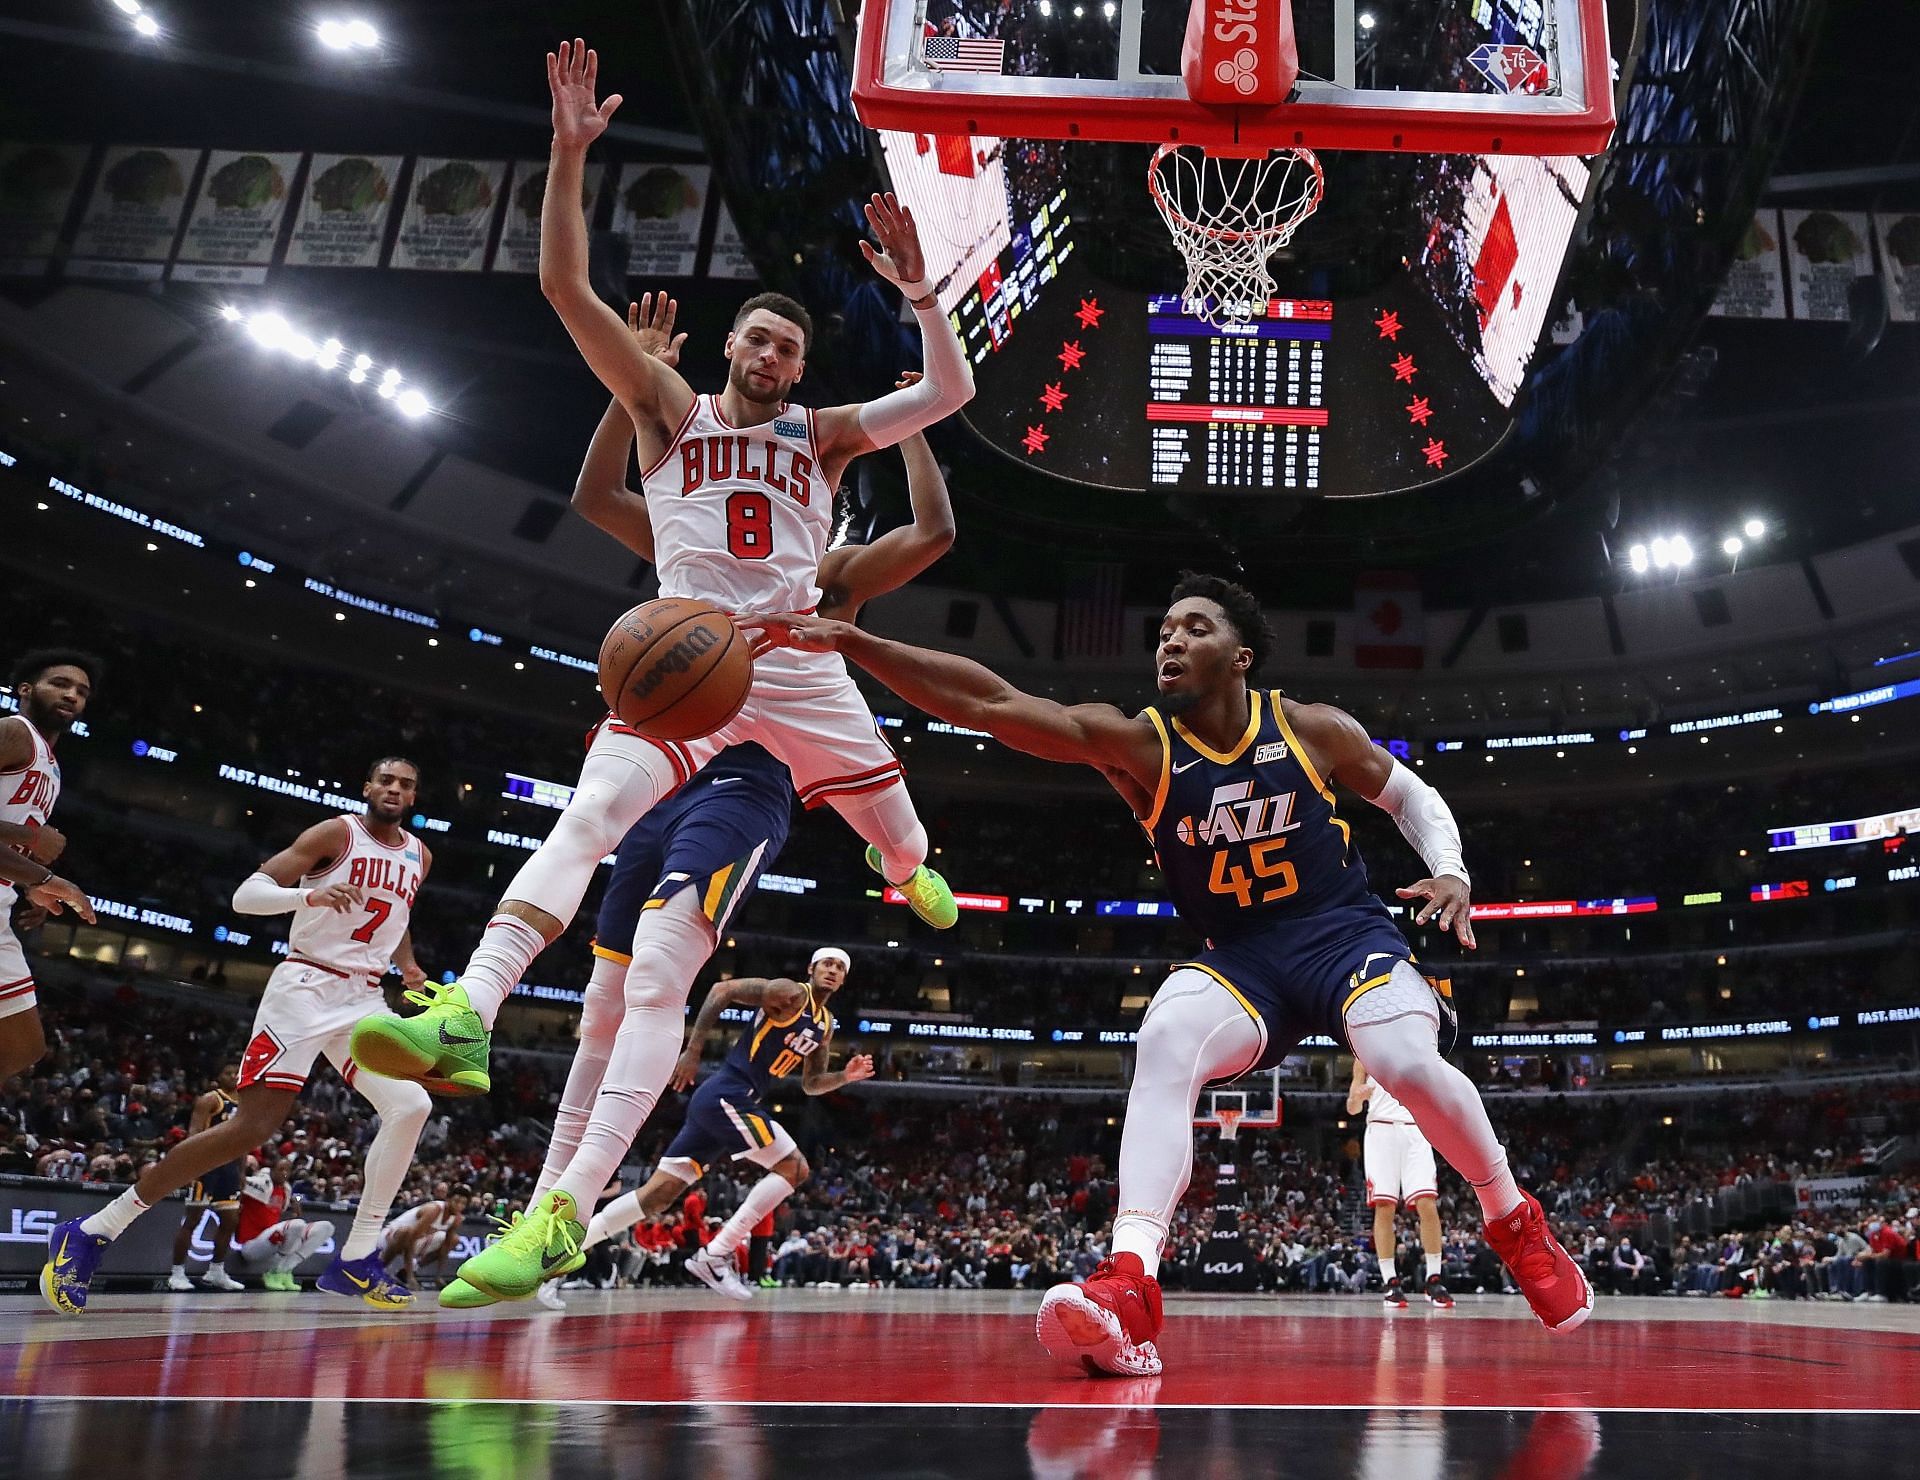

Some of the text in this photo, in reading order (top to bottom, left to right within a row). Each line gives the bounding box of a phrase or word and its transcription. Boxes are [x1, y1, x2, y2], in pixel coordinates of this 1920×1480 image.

[1512, 53, 1527, 68] 75
[680, 436, 813, 508] BULLS
[49, 476, 205, 548] FAST. RELIABLE. SECURE.
[726, 491, 773, 560] 8
[305, 577, 439, 629] FAST. RELIABLE. SECURE.
[529, 645, 558, 662] FAST.
[1670, 708, 1782, 734] FAST. RELIABLE. SECURE.
[1487, 733, 1594, 749] FAST. RELIABLE. SECURE.
[147, 746, 178, 762] AT&T
[1266, 750, 1285, 760] FIGHT
[219, 764, 368, 816] FAST. RELIABLE. SECUR
[1199, 780, 1301, 846] JAZZ
[488, 829, 520, 848] FAST.
[1208, 837, 1299, 907] 45
[1888, 866, 1919, 881] FAST.
[349, 857, 420, 909] BULLS
[140, 909, 193, 934] SECURE.
[350, 896, 392, 944] 7
[1858, 1006, 1920, 1025] FAST. RELIA
[870, 1022, 892, 1032] AT&T
[909, 1023, 1034, 1041] FAST. RELIABLE. SECURE.
[1063, 1032, 1083, 1041] AT&T
[1099, 1031, 1128, 1042] FAST.
[1662, 1020, 1792, 1040] FAST. RELIABLE. SECURE.
[1472, 1033, 1597, 1046] FAST. RELIABLE. SECURE.
